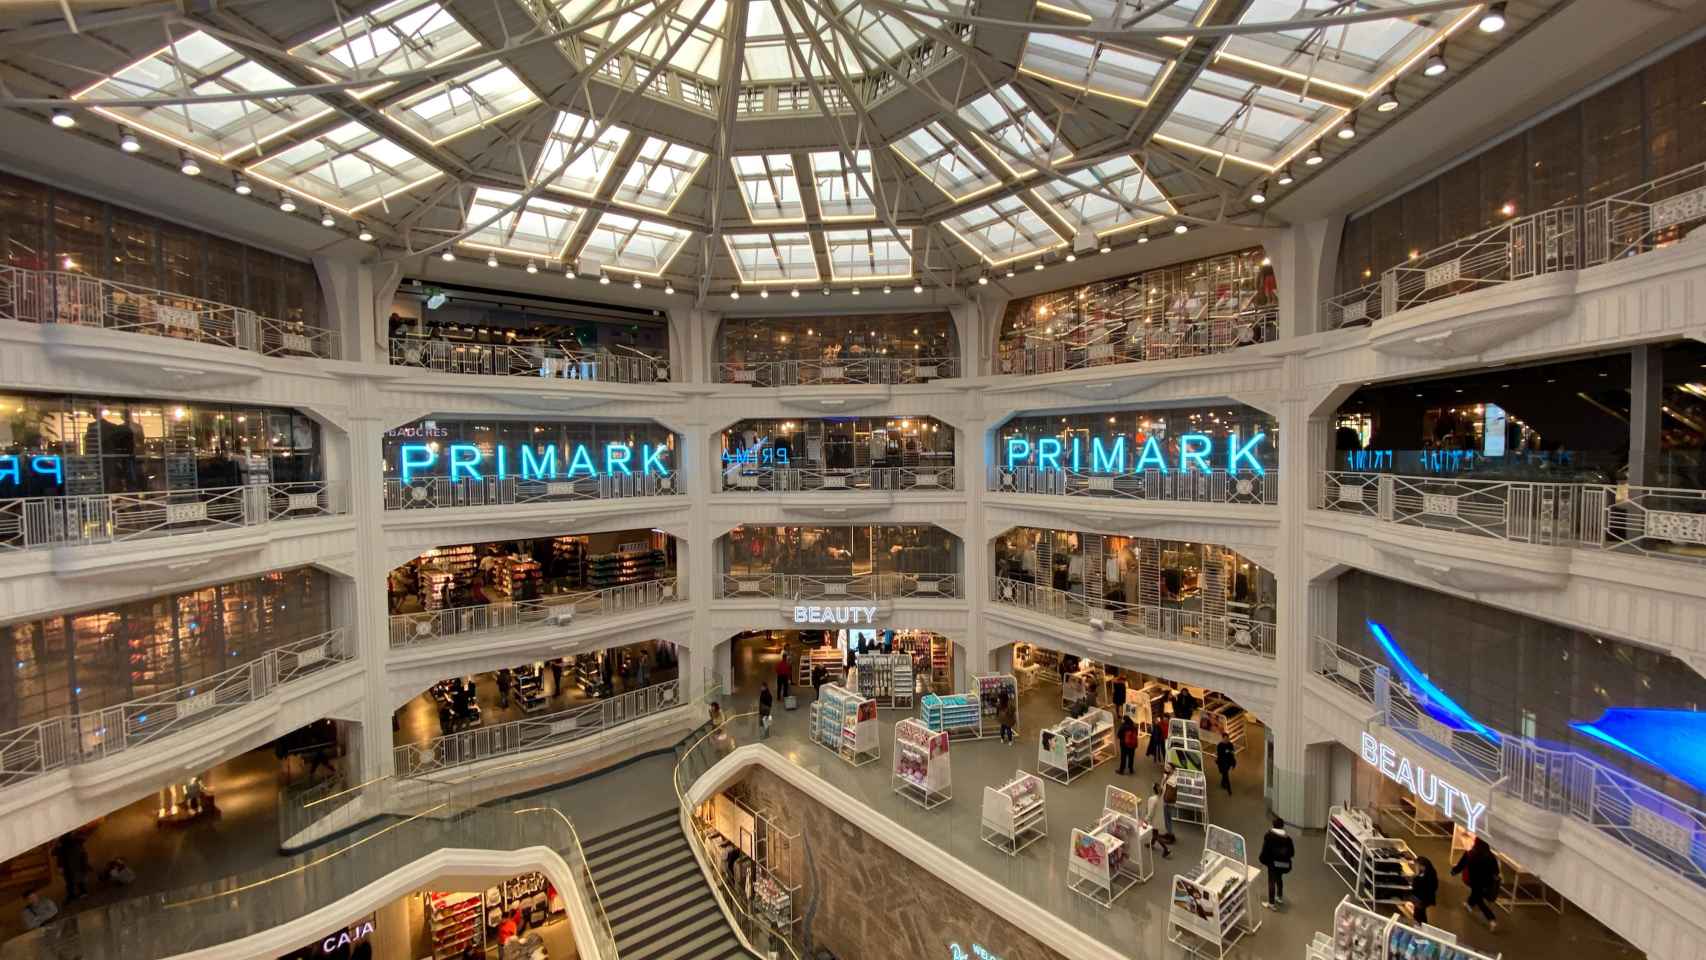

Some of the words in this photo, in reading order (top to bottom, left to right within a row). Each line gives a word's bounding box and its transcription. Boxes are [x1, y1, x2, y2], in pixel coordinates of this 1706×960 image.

[401, 443, 668, 484] PRIMARK
[1007, 433, 1265, 476] PRIMARK
[794, 606, 877, 624] BEAUTY
[1361, 731, 1486, 832] BEAUTY
[323, 922, 374, 952] CAJA
